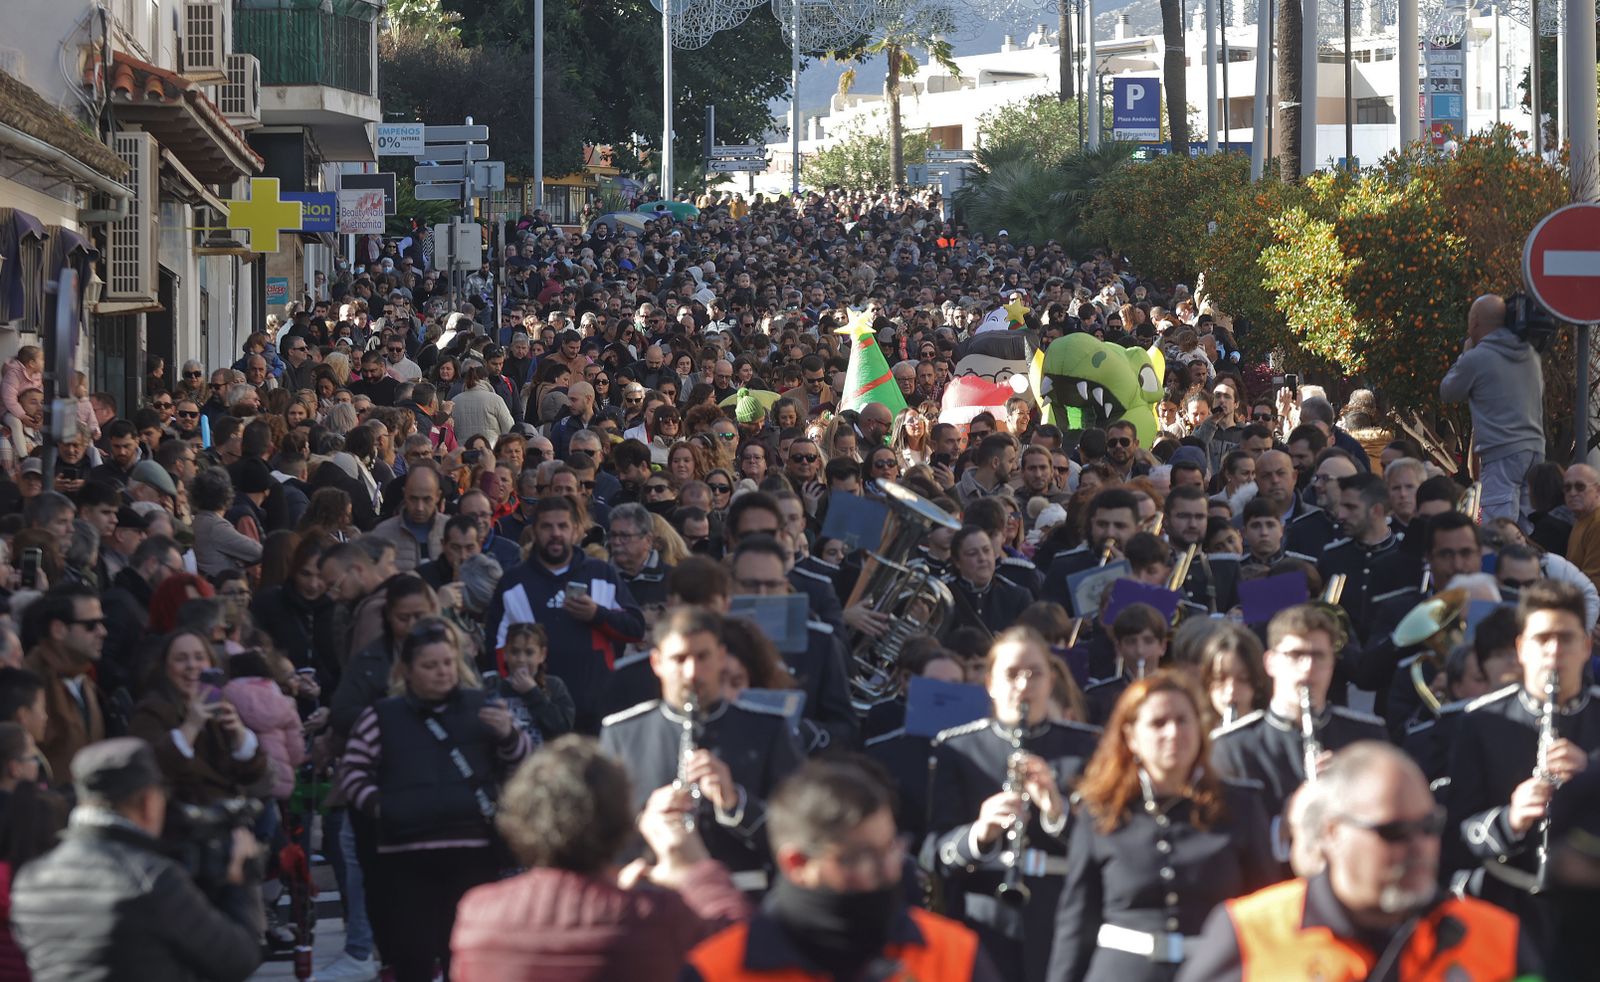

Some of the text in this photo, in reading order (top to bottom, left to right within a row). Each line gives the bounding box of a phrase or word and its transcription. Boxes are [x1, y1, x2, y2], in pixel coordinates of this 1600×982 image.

[1127, 84, 1145, 110] P
[378, 126, 420, 135] EMPEÑOS
[378, 136, 401, 148] 0%
[342, 207, 384, 219] Beauty Nails
[344, 219, 382, 229] Vietnamita
